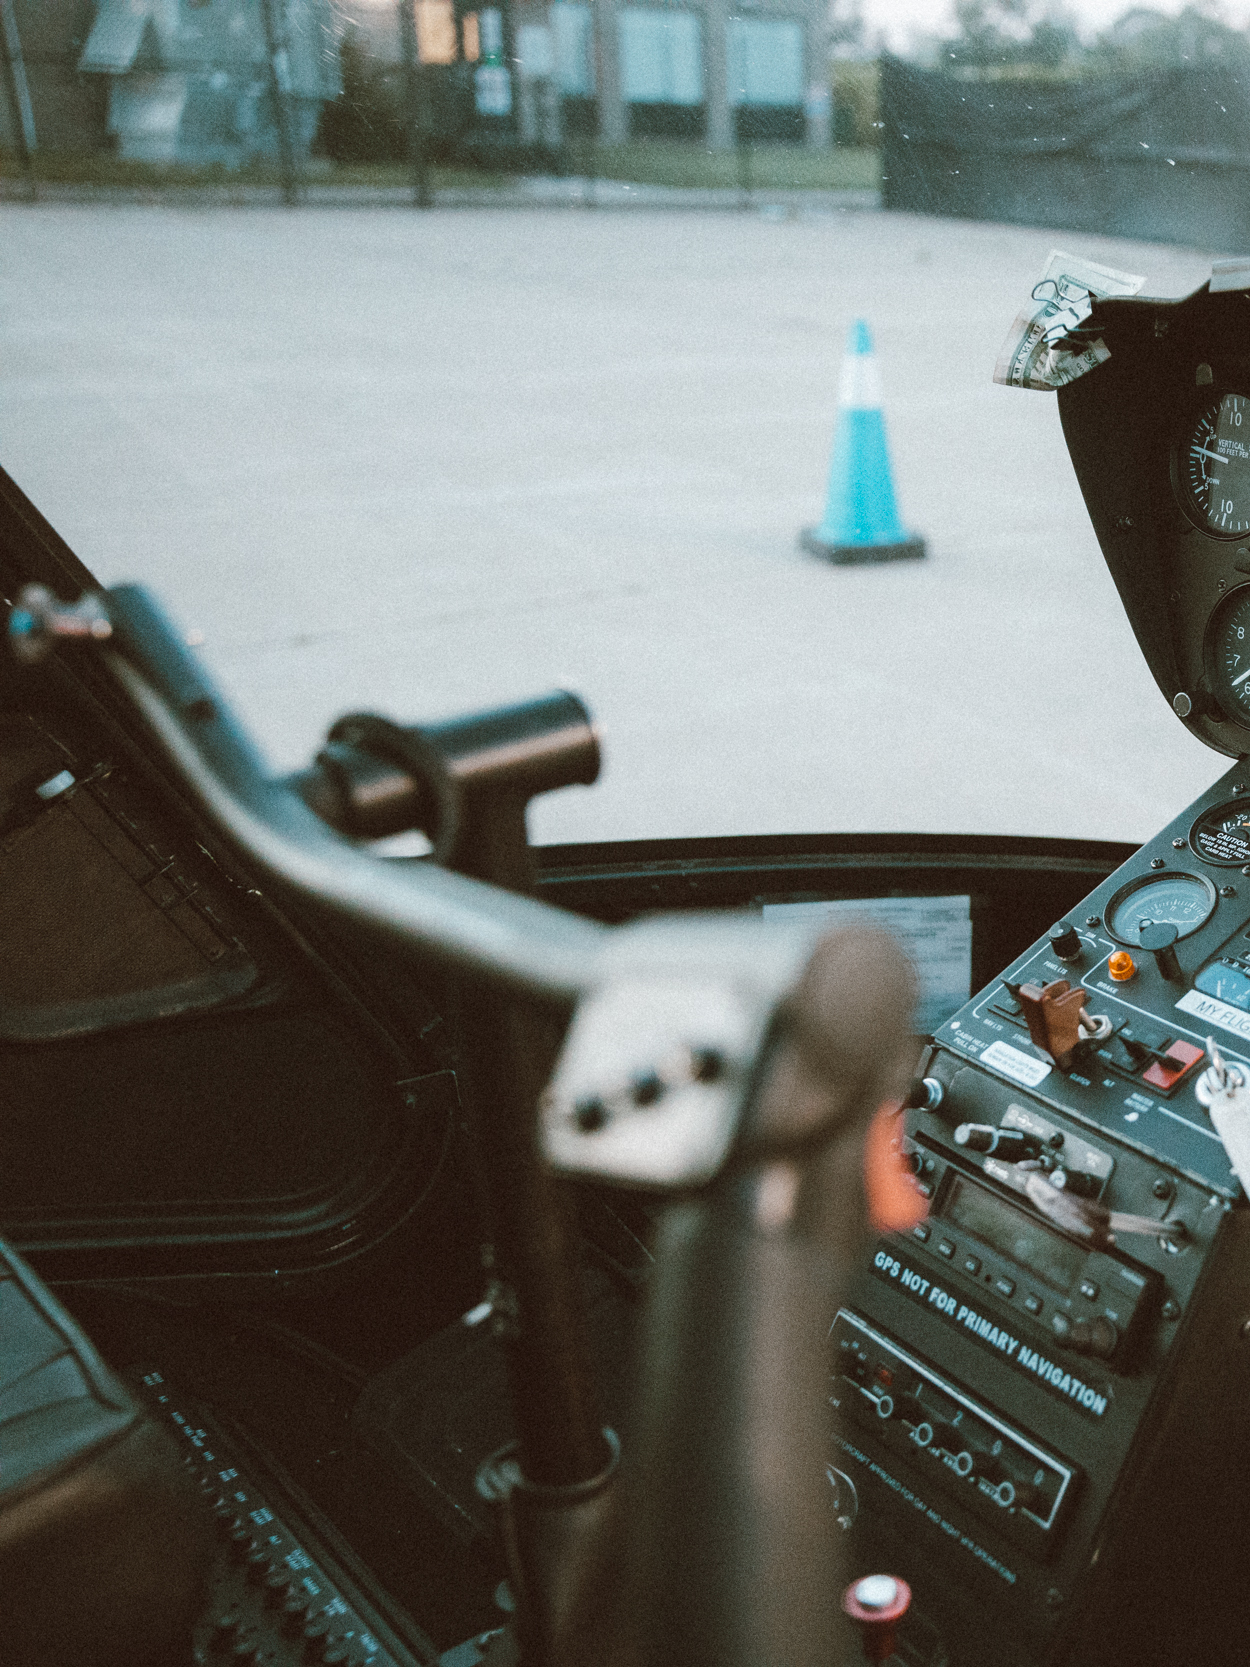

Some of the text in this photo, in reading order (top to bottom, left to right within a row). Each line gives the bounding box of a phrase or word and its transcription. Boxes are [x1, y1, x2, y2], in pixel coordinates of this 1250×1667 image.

[1229, 411, 1242, 427] 10
[1218, 439, 1245, 452] VERTICAL
[1226, 448, 1239, 457] FEET
[1239, 451, 1249, 460] PER
[1221, 499, 1234, 514] 10
[1237, 626, 1245, 639] 8
[1233, 653, 1241, 667] 7
[1199, 832, 1218, 842] BELOW
[1216, 832, 1249, 848] CAUTION
[1217, 845, 1235, 855] APPLY
[1043, 960, 1057, 972] PANEL
[1095, 981, 1119, 995] BRAKE
[1196, 1000, 1218, 1017] MY
[954, 1029, 989, 1050] CABIN HEAT
[874, 1250, 1109, 1416] GPS NOT FOR PRIMARY NAVIGATION
[951, 1410, 963, 1428] 2
